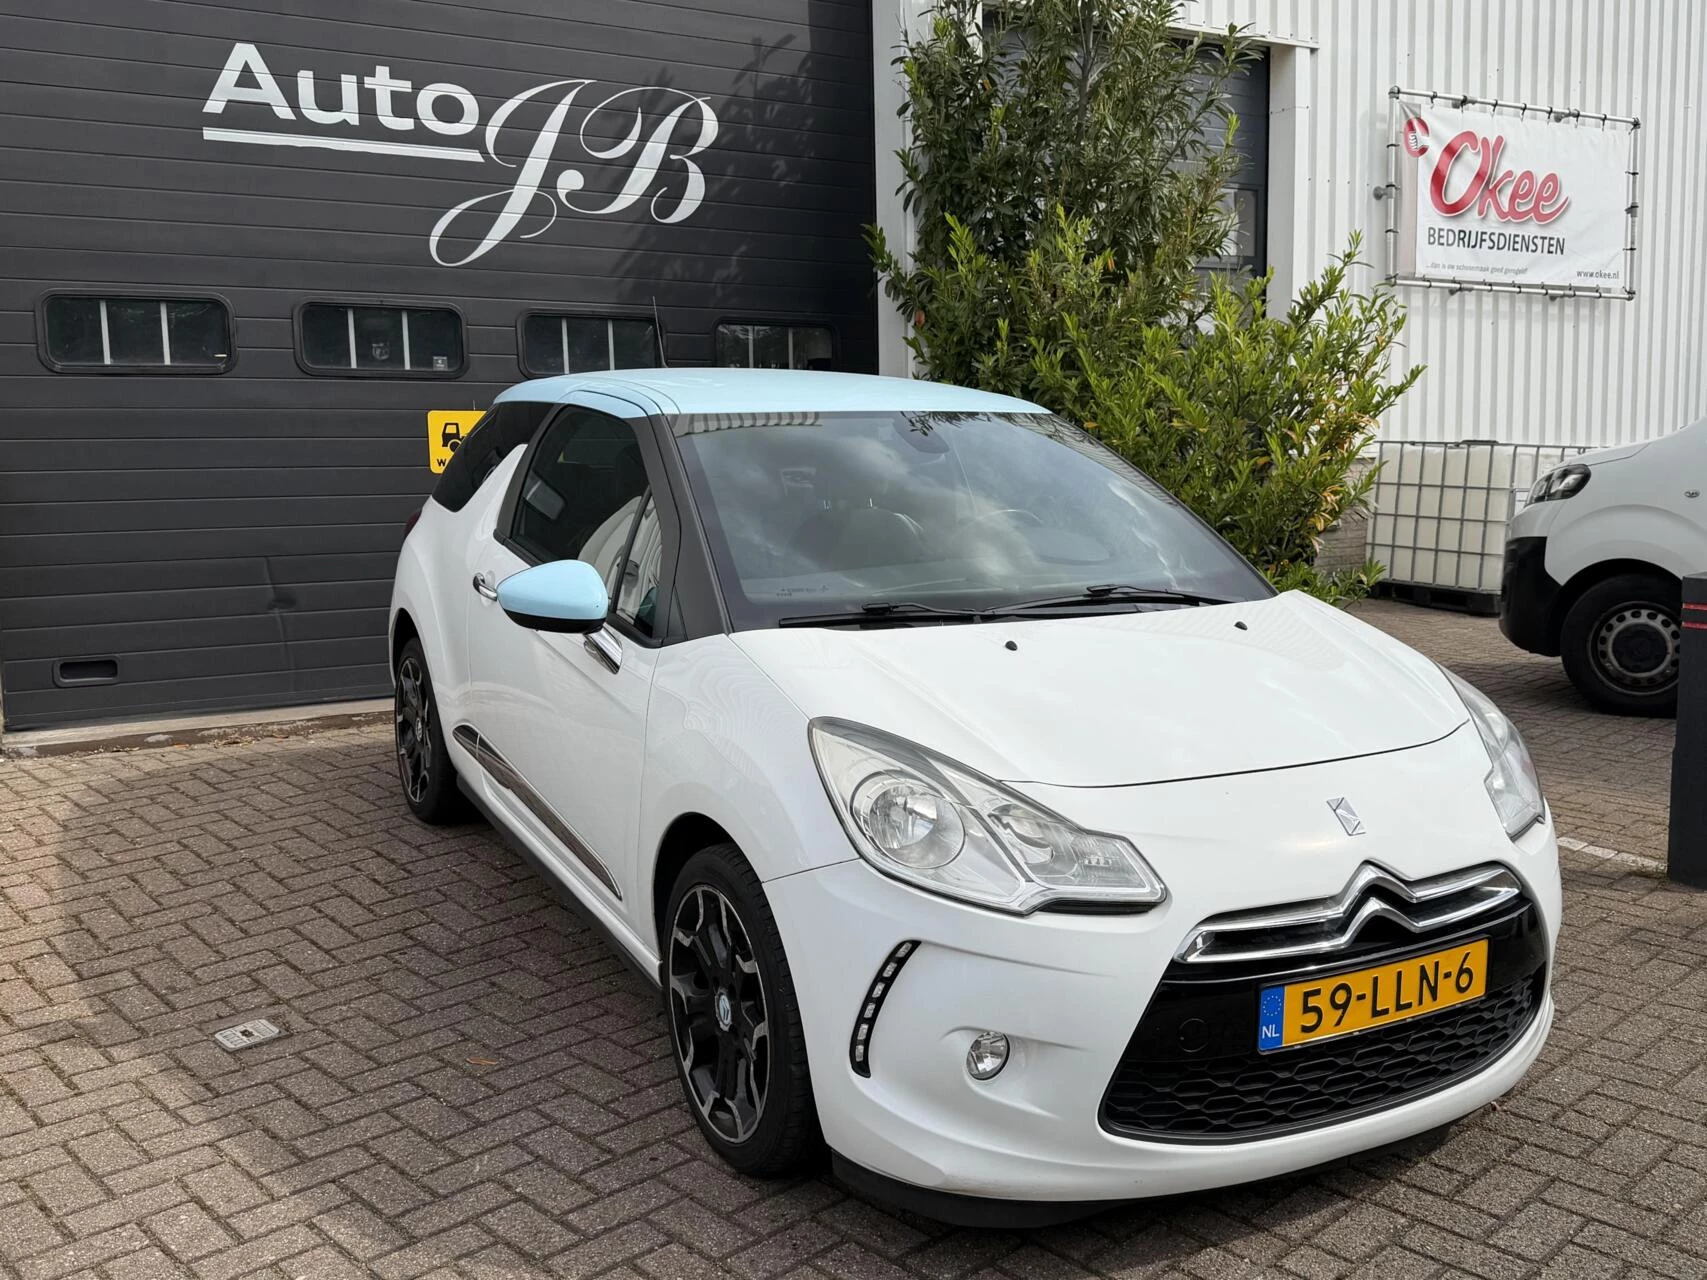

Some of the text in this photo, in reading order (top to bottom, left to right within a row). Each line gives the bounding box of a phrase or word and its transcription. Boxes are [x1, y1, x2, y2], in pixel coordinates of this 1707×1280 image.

[202, 43, 719, 267] Auto JB
[1429, 129, 1570, 225] Okee
[1427, 226, 1566, 256] BEDRIJFSDIENSTEN
[1576, 269, 1620, 280] www.okee.nl
[1300, 951, 1474, 1034] 59-LLN-6
[1262, 1024, 1280, 1039] NL
